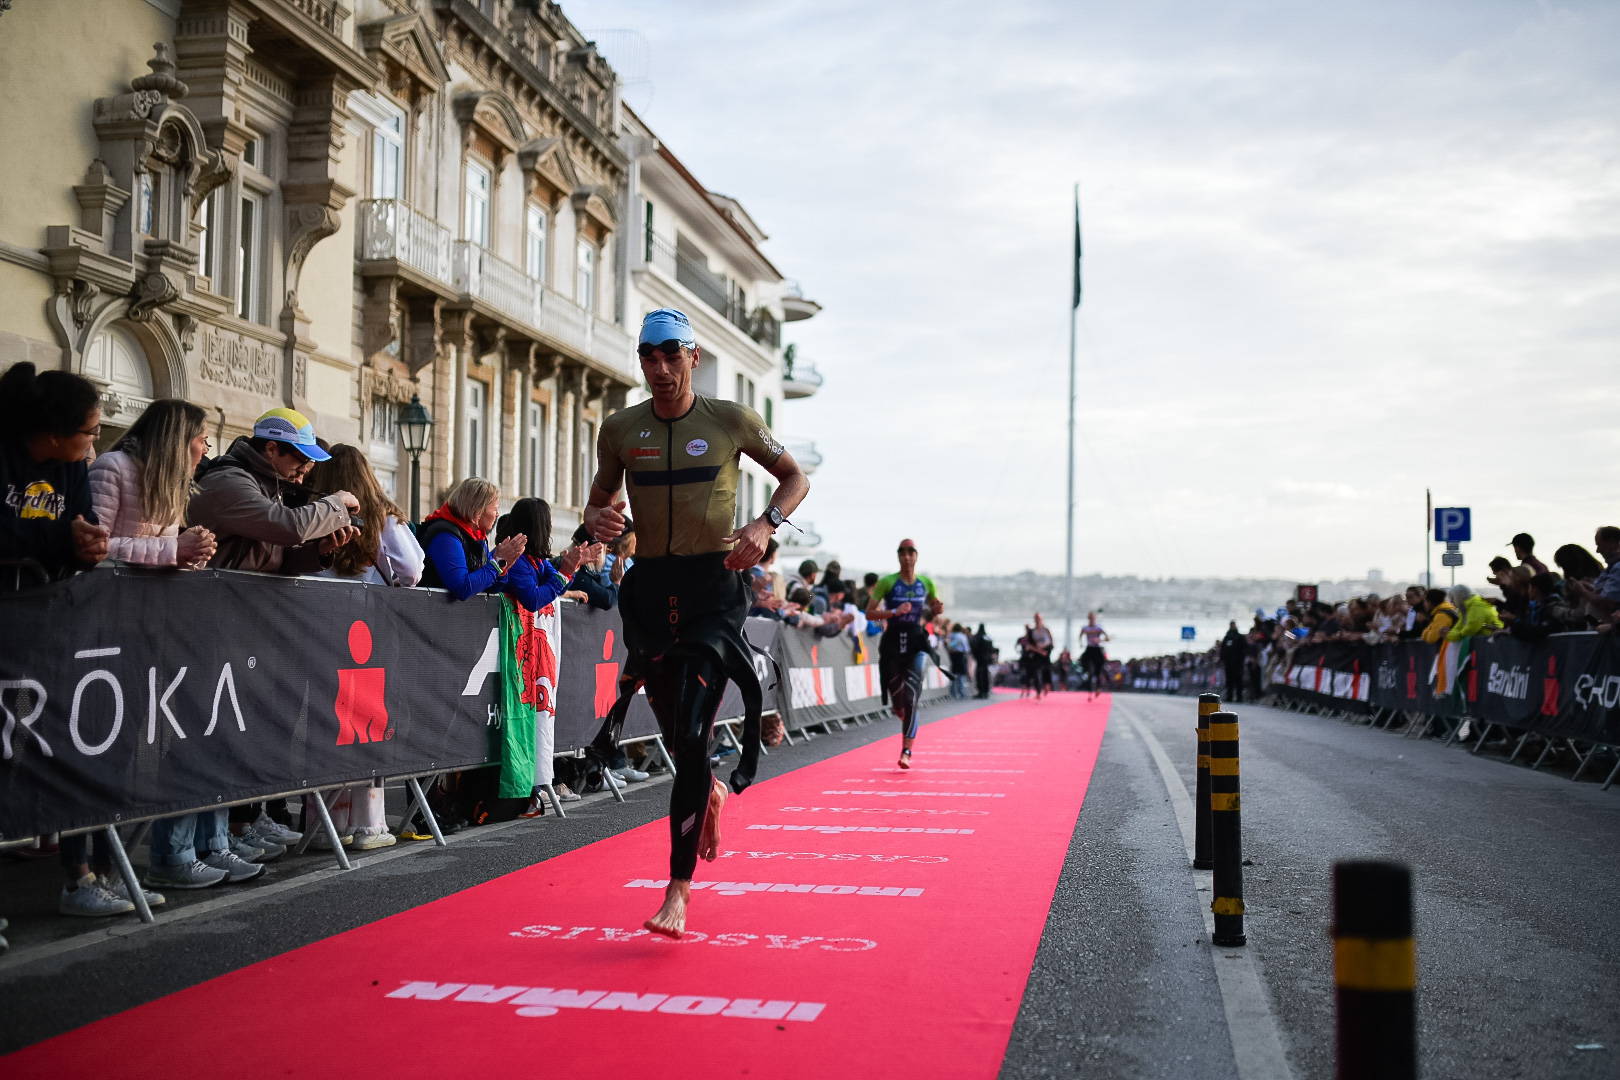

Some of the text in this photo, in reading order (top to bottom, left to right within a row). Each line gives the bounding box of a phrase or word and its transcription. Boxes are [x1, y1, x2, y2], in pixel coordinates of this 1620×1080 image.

[1441, 509, 1464, 541] P
[745, 824, 975, 835] IRONMAN
[718, 850, 949, 864] CASCAI
[623, 879, 926, 897] IRONMAN
[508, 925, 878, 953] CASCAIS
[385, 981, 827, 1022] IRONMAN
